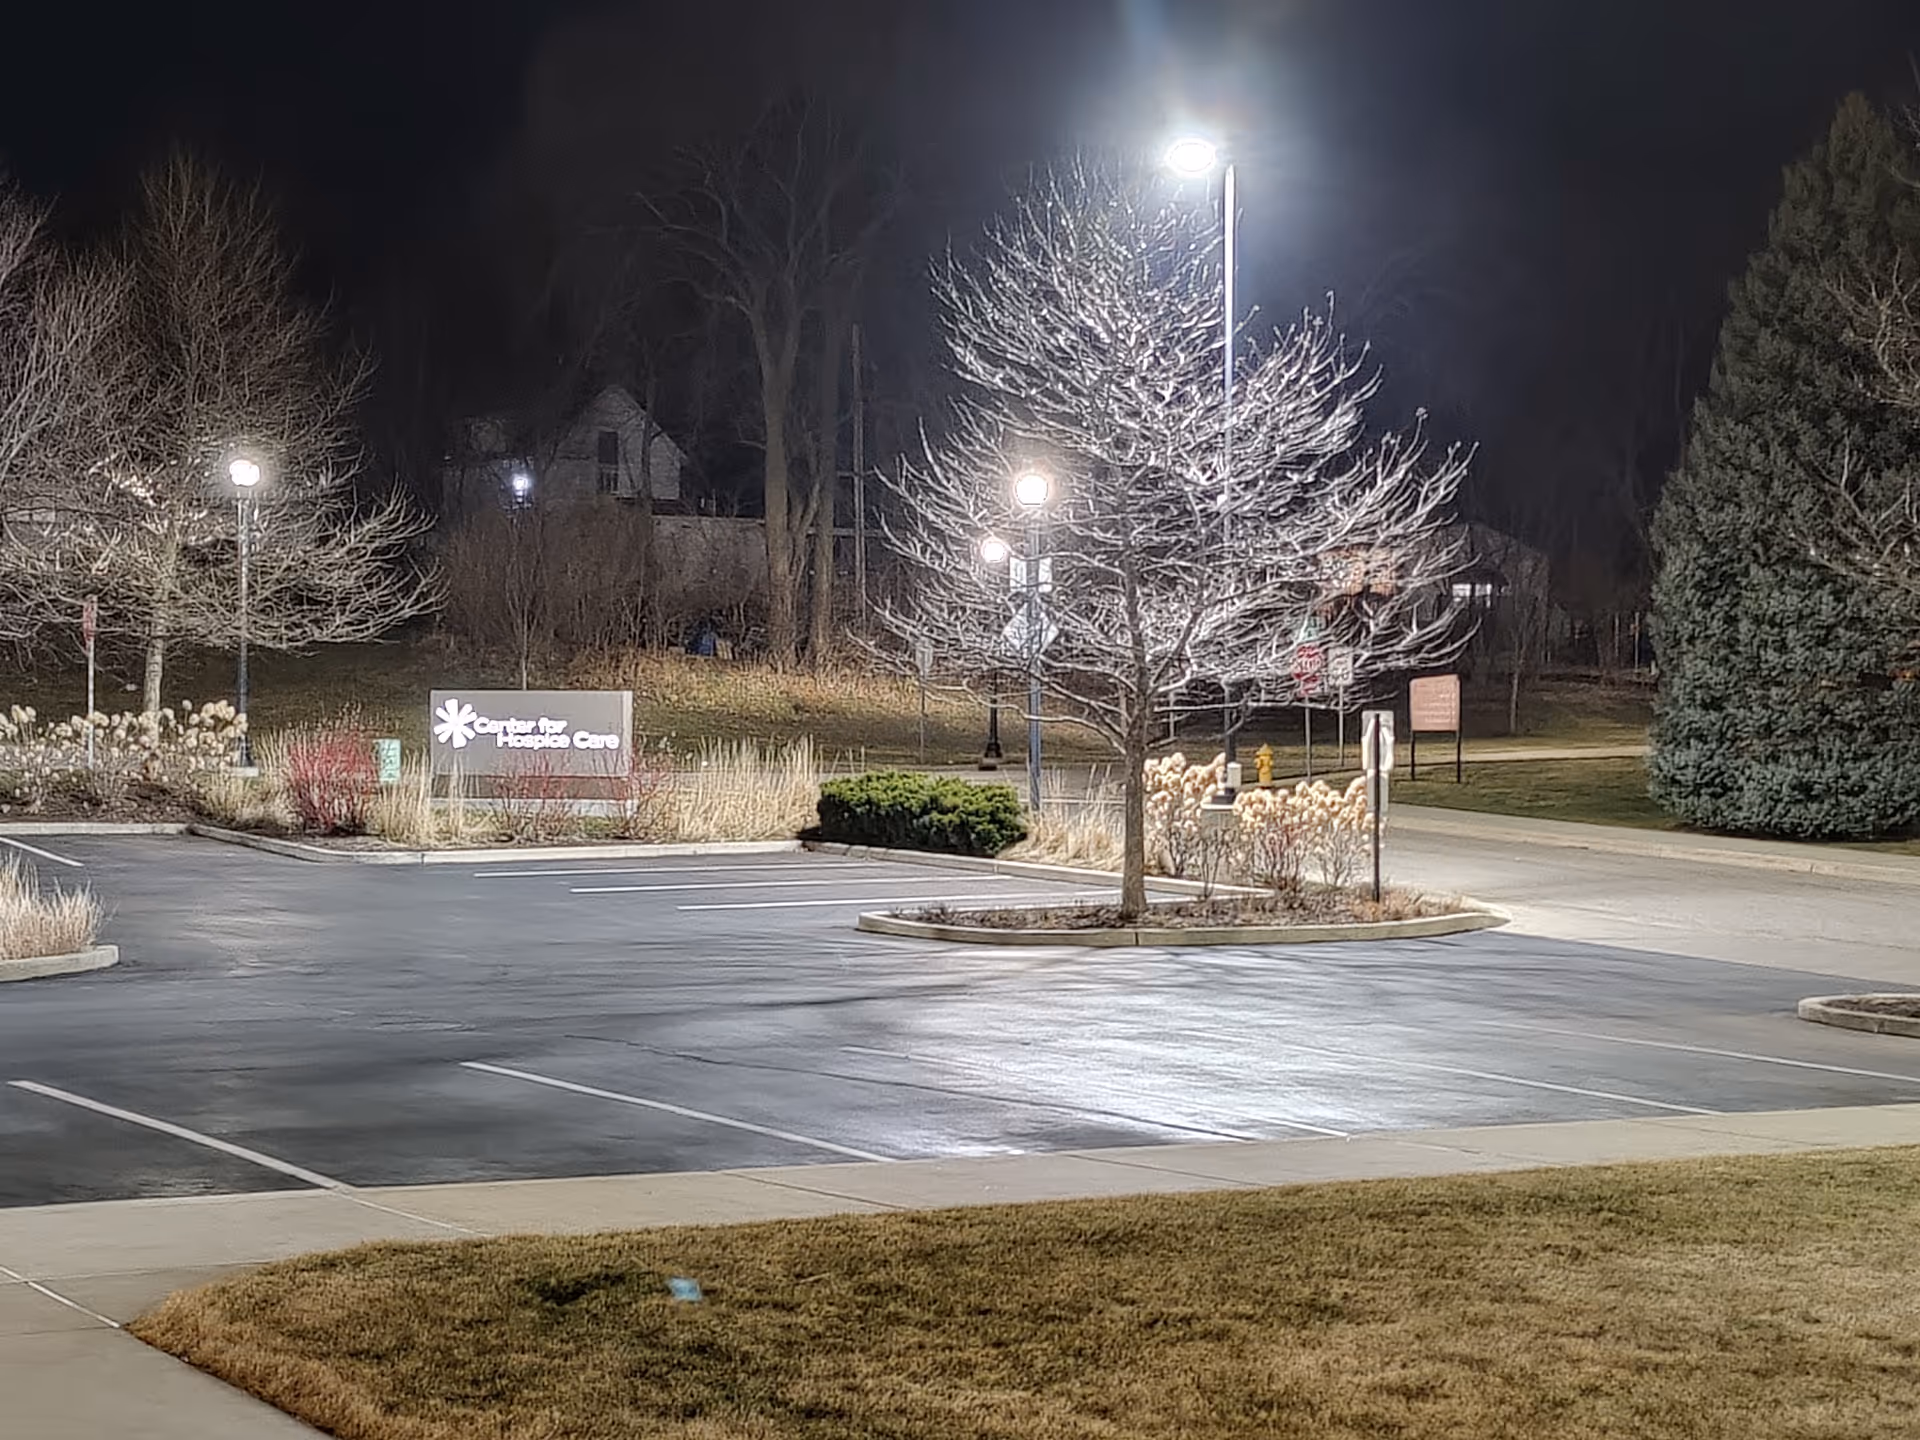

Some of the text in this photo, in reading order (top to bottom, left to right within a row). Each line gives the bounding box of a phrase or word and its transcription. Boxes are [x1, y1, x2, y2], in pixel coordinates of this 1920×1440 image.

[473, 716, 568, 734] Center for
[496, 730, 620, 750] Hospice Care
